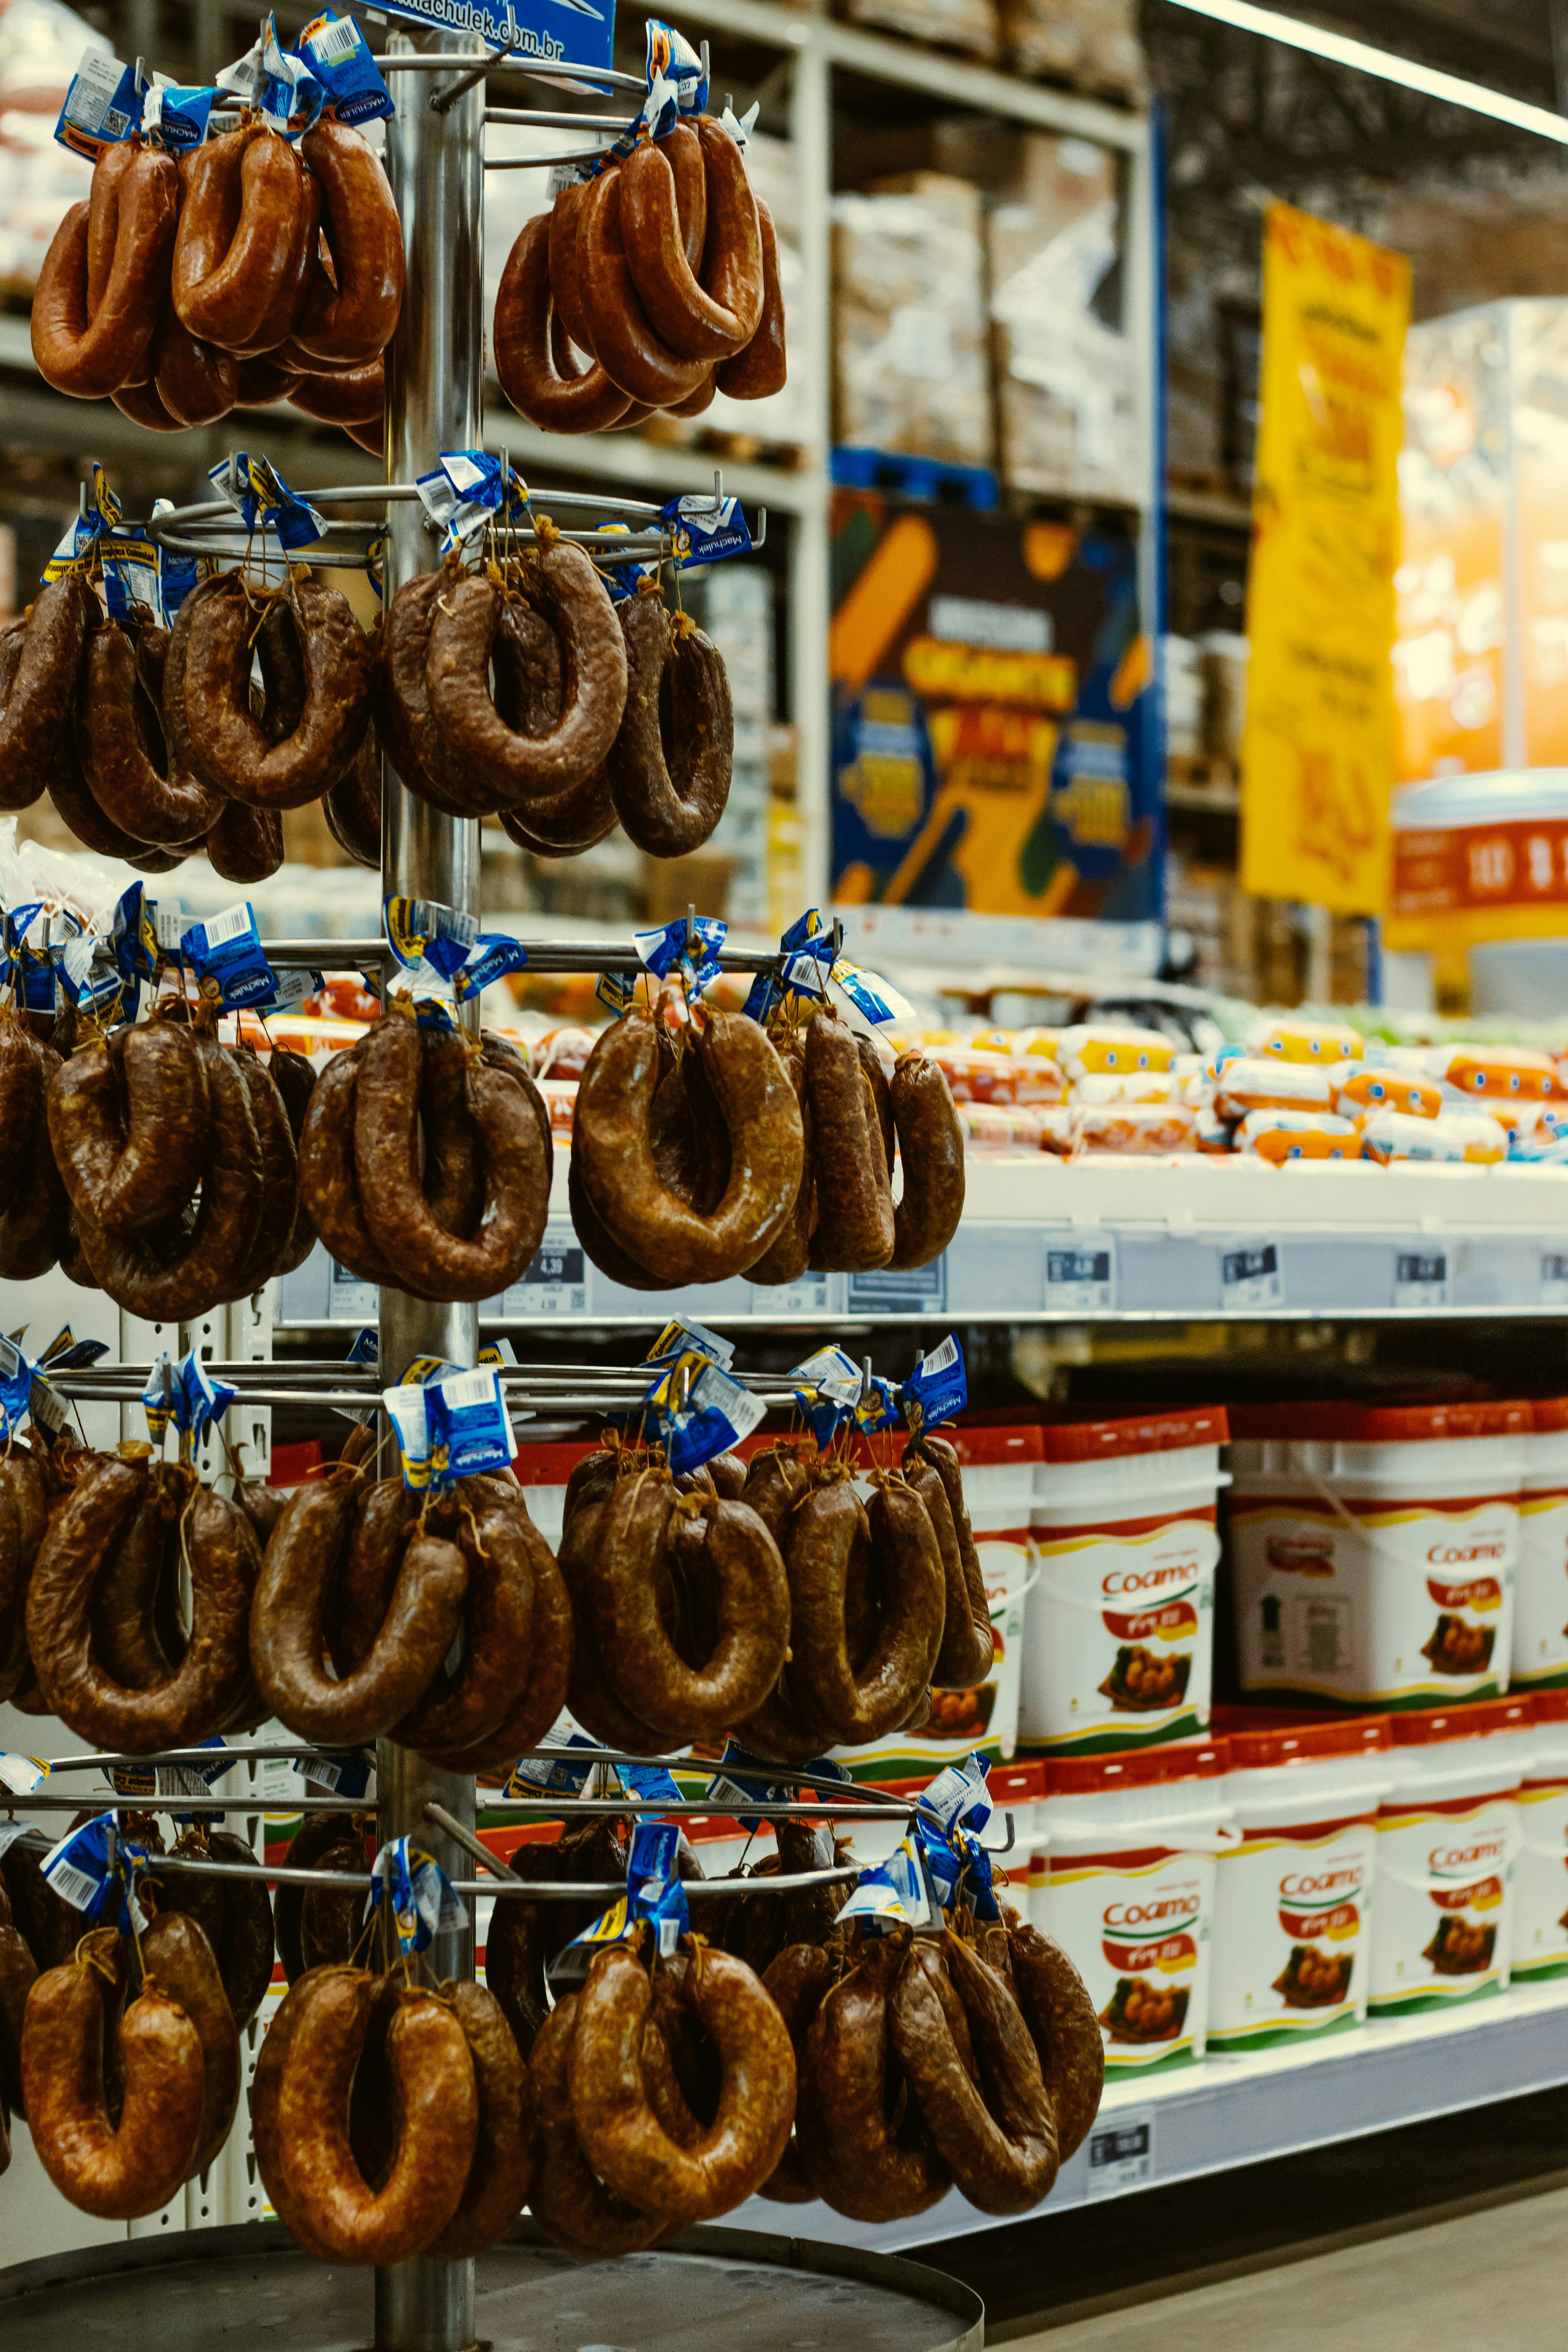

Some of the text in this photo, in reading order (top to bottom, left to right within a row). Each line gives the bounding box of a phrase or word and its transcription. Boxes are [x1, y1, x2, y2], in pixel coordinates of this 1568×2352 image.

[698, 535, 742, 555] Machulek
[228, 975, 270, 1000] Machulek
[927, 1395, 961, 1421] Machulek
[1279, 1866, 1363, 1896] Coamo
[1103, 1894, 1200, 1926] Coamo
